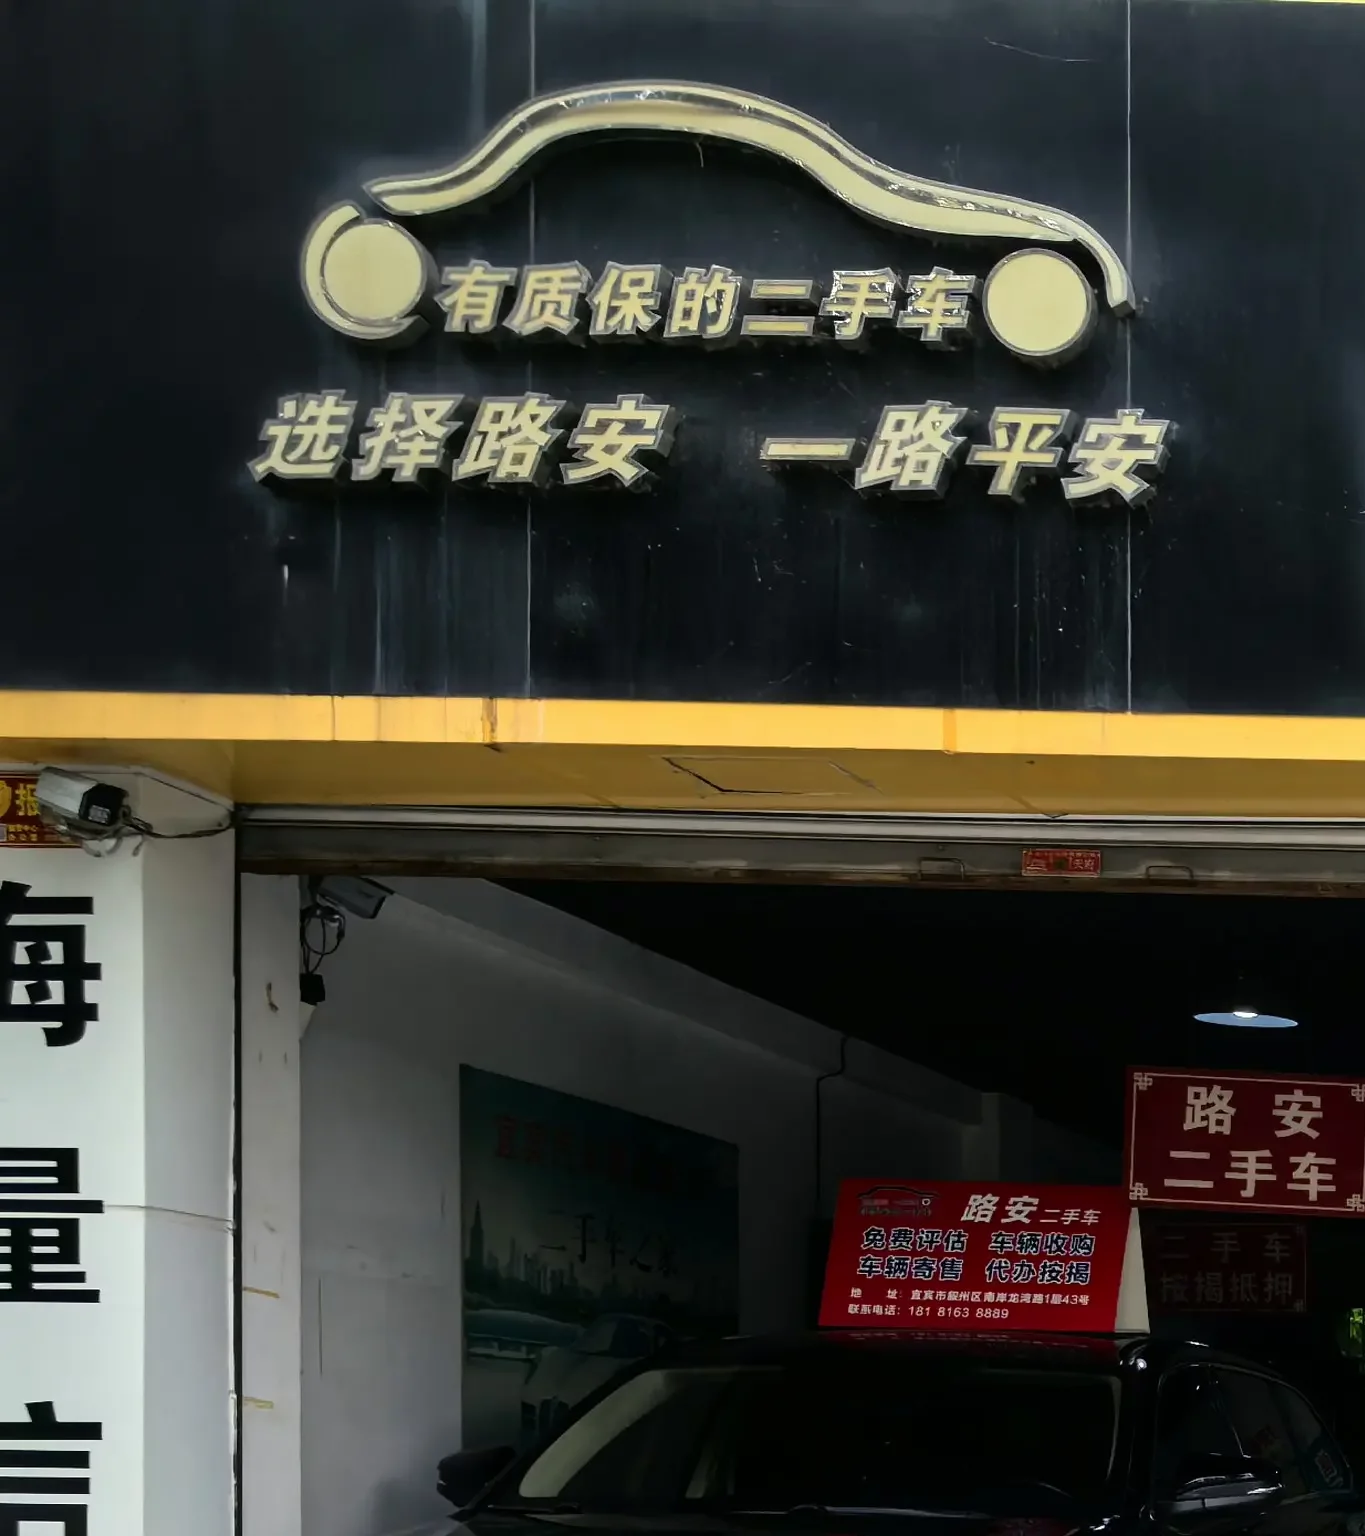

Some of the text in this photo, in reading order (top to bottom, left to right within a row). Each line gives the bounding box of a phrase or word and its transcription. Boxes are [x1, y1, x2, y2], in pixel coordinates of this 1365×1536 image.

[434, 258, 982, 346] 有质保的二手车
[249, 388, 1175, 505] 选择路安 一路平安
[1183, 1085, 1323, 1139] 路安
[1164, 1149, 1337, 1201] 二手车
[861, 1226, 1096, 1256] 免费评估 车辆收购
[857, 1254, 1091, 1285] 车辆寄售 代办按揭
